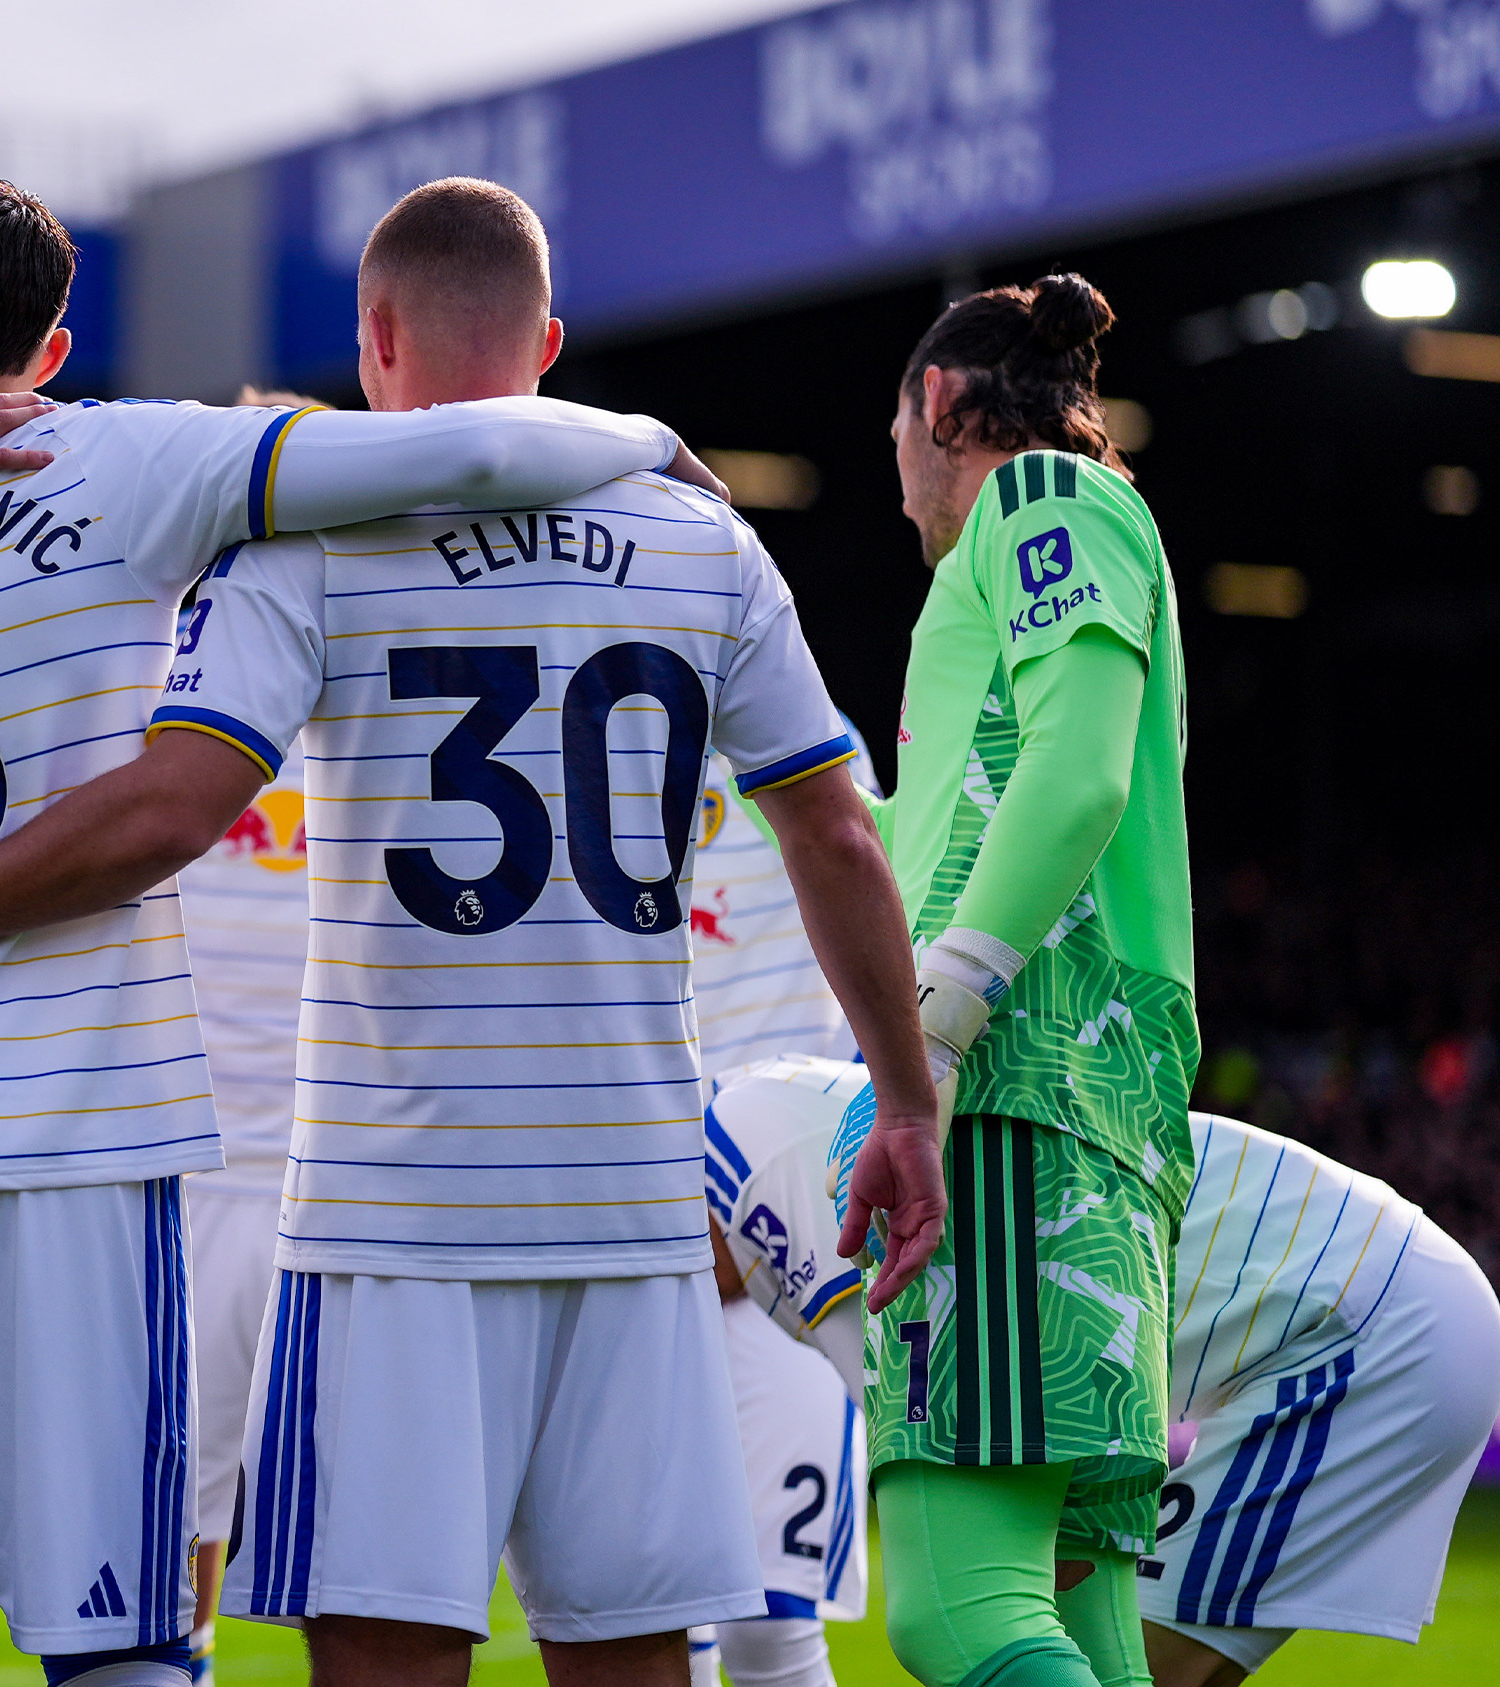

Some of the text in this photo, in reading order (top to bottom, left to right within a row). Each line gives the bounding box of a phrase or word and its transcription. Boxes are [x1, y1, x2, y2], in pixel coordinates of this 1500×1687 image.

[431, 512, 636, 588] ELVEDI
[1009, 582, 1102, 643] KChat
[383, 640, 710, 936] 30
[899, 1320, 931, 1424] 1
[783, 1464, 825, 1560] 2
